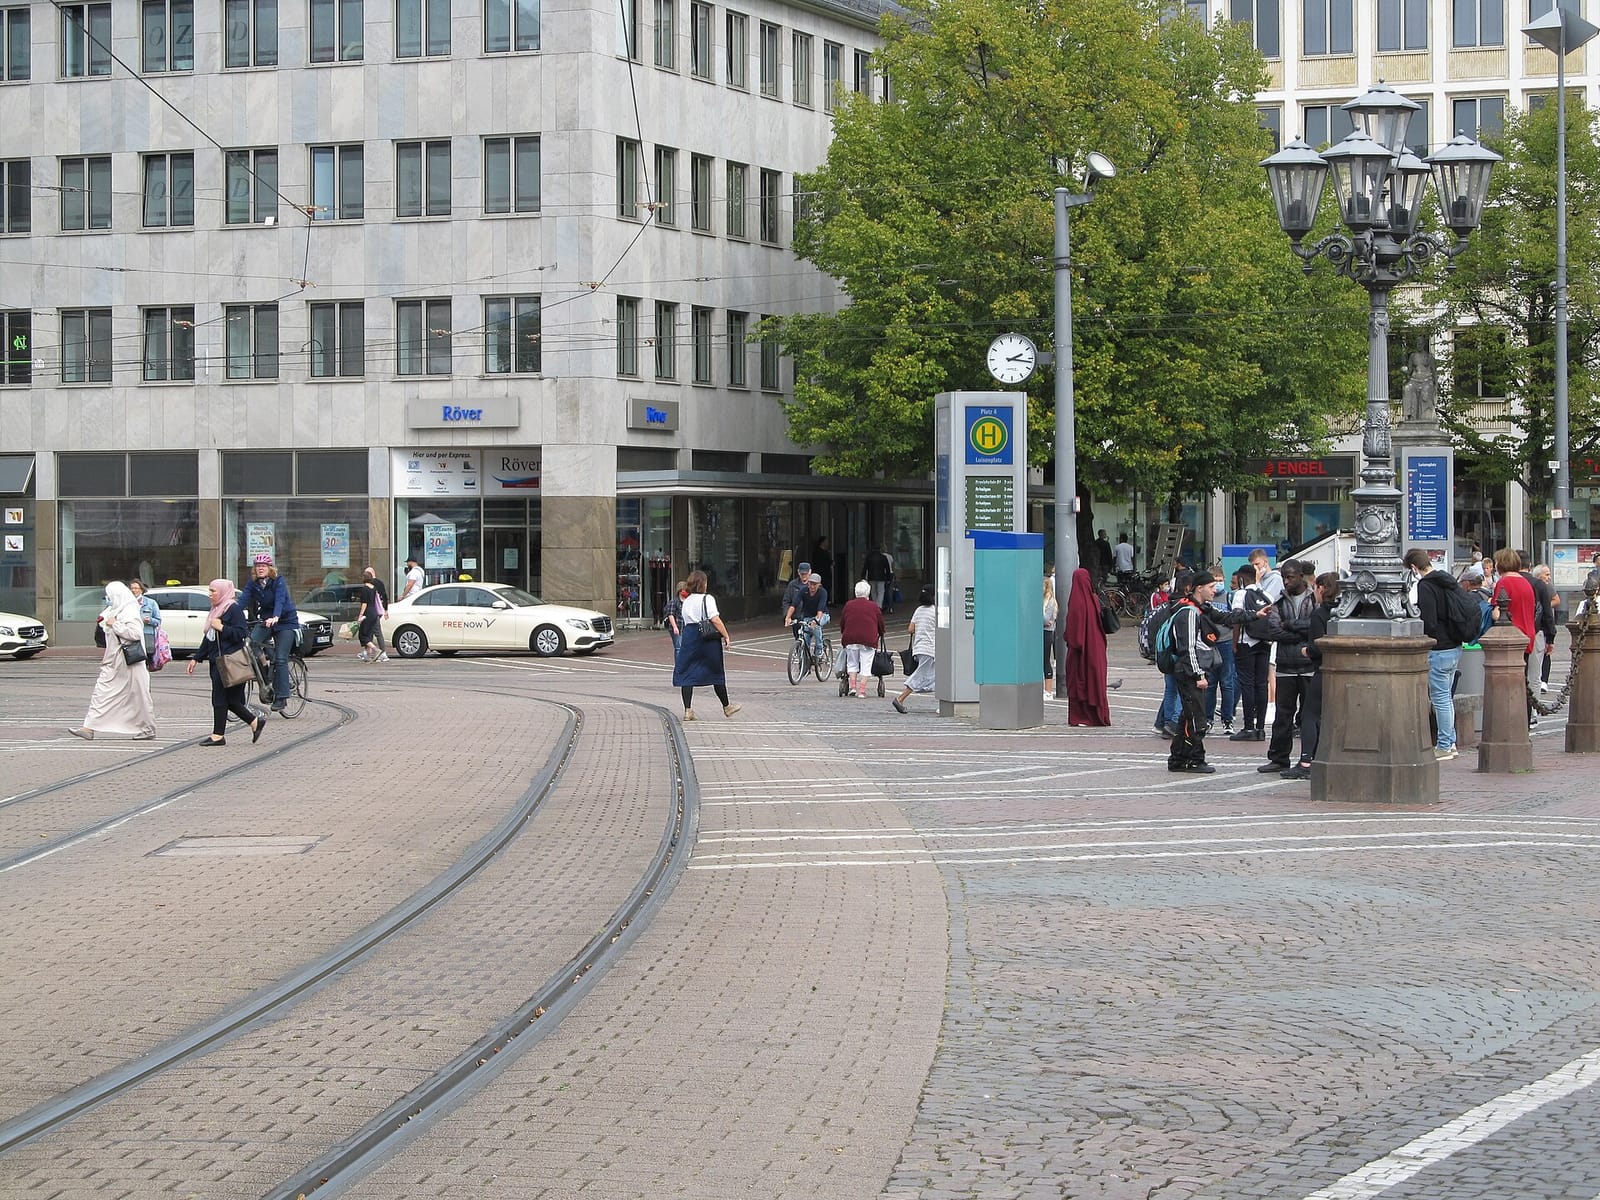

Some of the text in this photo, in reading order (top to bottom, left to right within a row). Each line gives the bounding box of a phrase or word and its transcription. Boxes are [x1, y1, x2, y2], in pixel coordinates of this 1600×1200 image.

[443, 406, 483, 421] Röver
[981, 425, 996, 446] H
[438, 452, 448, 460] per
[501, 456, 541, 471] Röver
[1277, 461, 1328, 475] ENGEL
